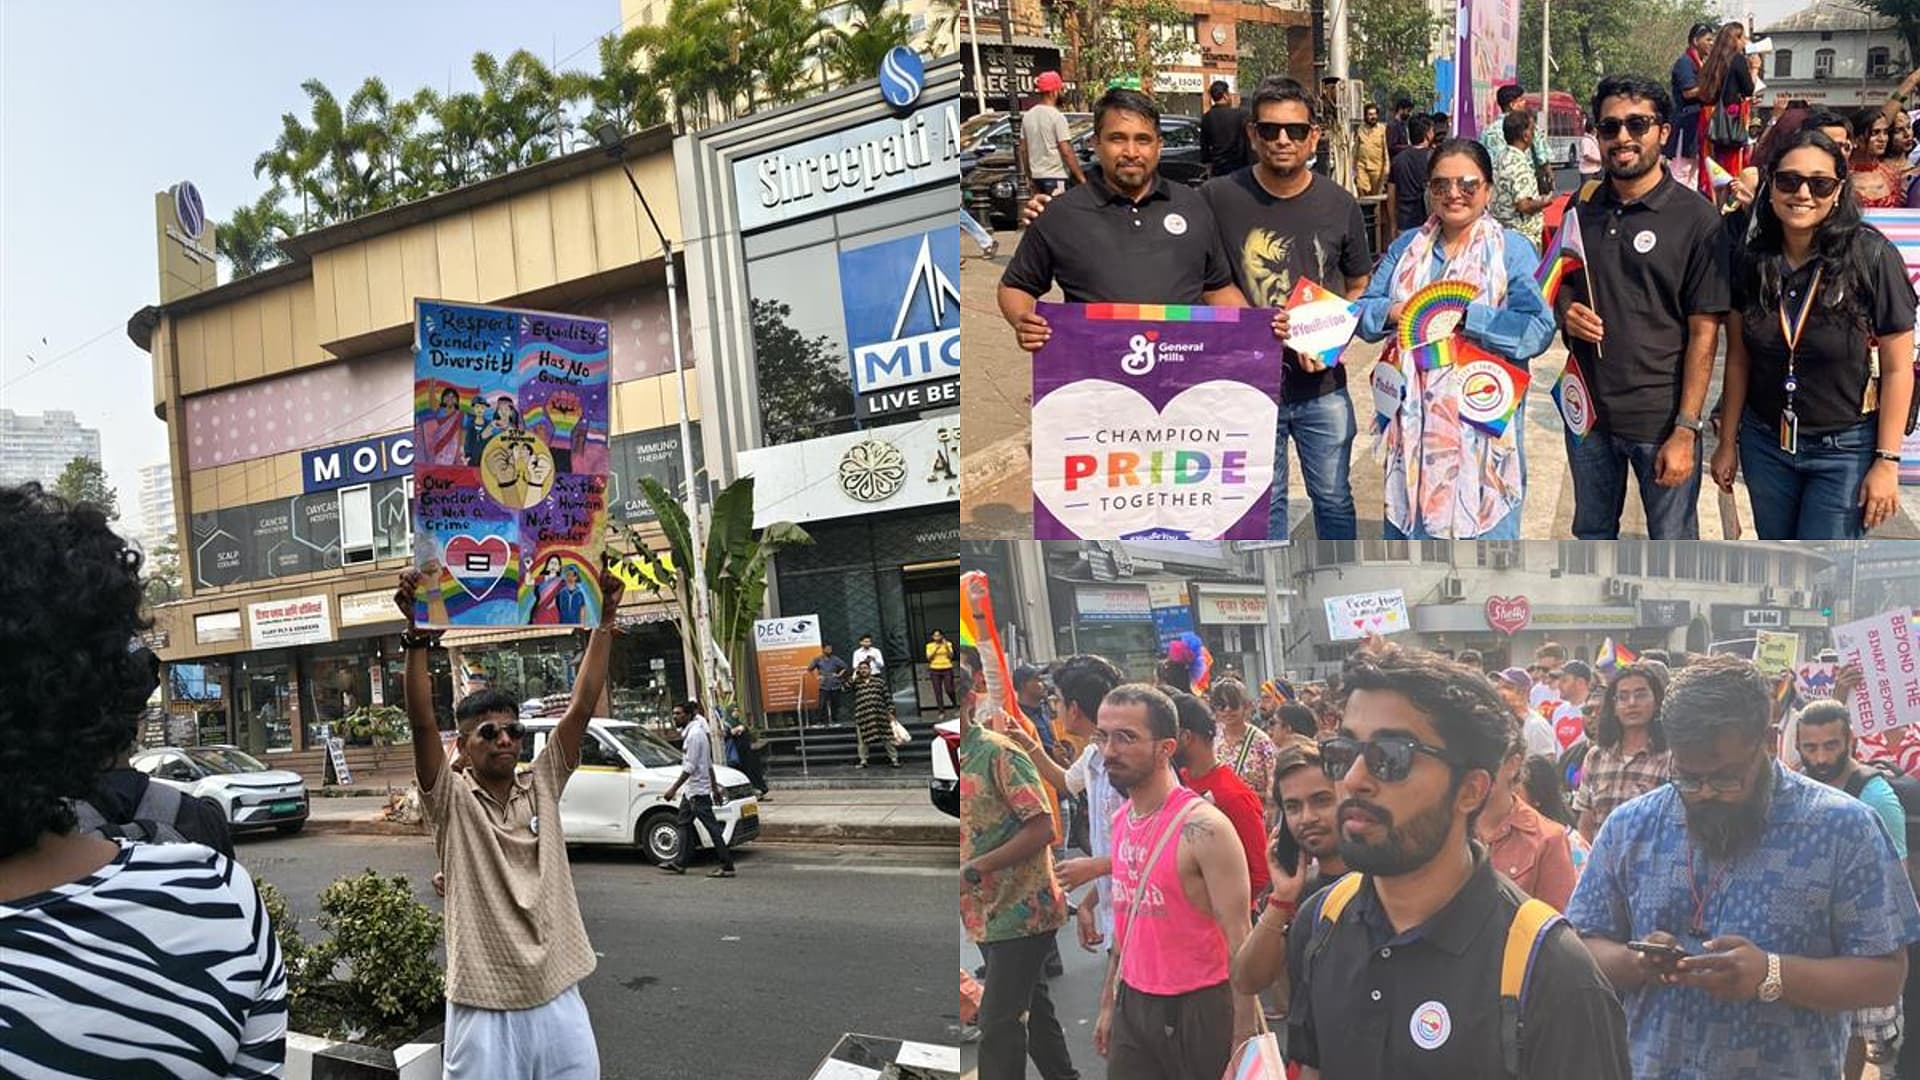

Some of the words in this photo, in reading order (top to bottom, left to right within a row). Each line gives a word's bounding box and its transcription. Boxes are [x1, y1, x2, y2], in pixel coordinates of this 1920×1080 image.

[758, 113, 932, 208] Shreepati
[442, 311, 514, 334] Respect
[532, 320, 597, 345] Equality
[429, 333, 491, 351] Gender
[1159, 342, 1204, 352] General
[429, 350, 514, 375] Diversity
[538, 351, 564, 368] Has
[566, 361, 590, 378] No
[1159, 353, 1185, 362] Mills
[869, 389, 920, 413] LIVE
[1095, 428, 1221, 444] CHAMPION
[636, 440, 678, 455] IMMUNO
[638, 451, 673, 464] THERAPY
[1063, 450, 1247, 492] PRIDE
[423, 475, 452, 490] Our
[421, 491, 475, 506] Gender
[559, 497, 602, 511] Human
[1100, 492, 1213, 512] TOGETHER
[538, 529, 586, 542] Gender
[217, 551, 239, 561] SCALP
[758, 622, 784, 637] DEC
[1891, 615, 1915, 674] BEYOND
[1905, 677, 1920, 708] THE
[1868, 629, 1887, 673] BINARY
[1878, 678, 1898, 727] BEYOND
[1855, 682, 1875, 731] BREED
